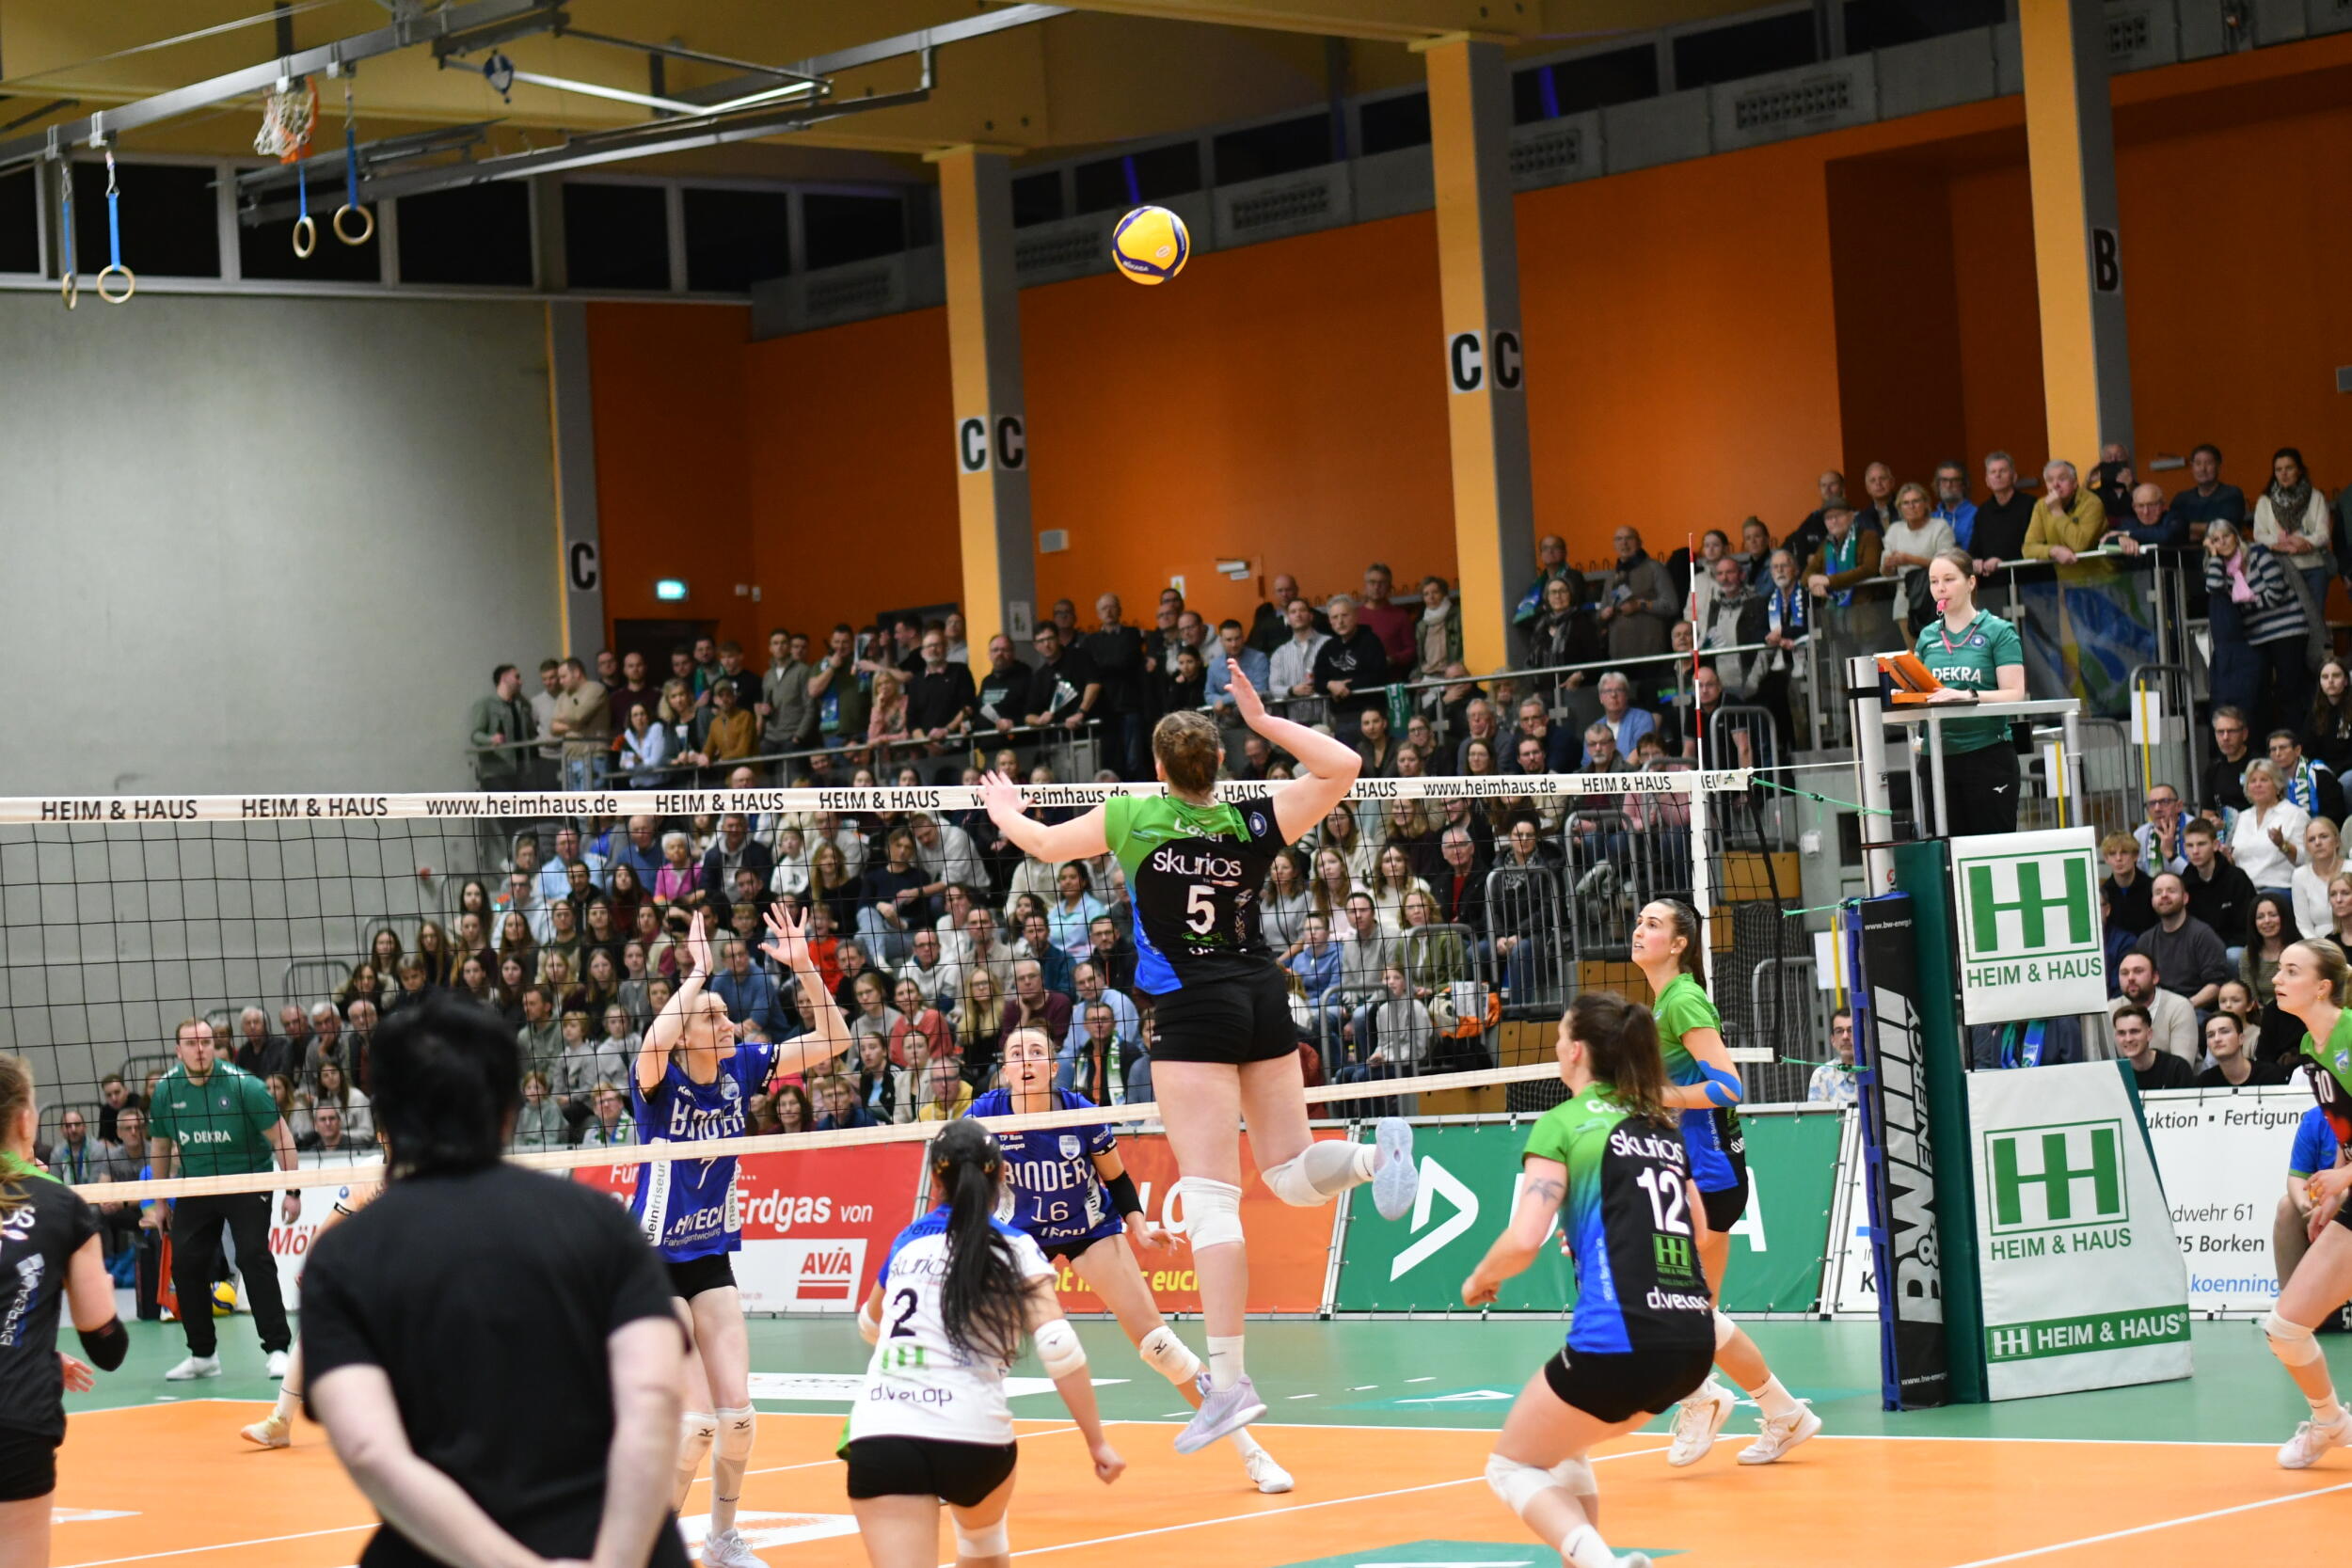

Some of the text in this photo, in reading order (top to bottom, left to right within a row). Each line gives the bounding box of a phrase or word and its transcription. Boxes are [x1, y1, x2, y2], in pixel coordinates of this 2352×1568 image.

[2093, 229, 2119, 292] B
[1451, 333, 1482, 391] C
[1494, 331, 1520, 389] C
[961, 418, 986, 471] C
[997, 416, 1025, 468] C
[570, 542, 596, 591] C
[1931, 666, 1981, 684] DEKRA
[41, 800, 102, 821] HEIM
[109, 800, 126, 820] &
[134, 800, 199, 819] HAUS
[241, 799, 299, 818] HEIM
[306, 798, 322, 817] &
[328, 797, 388, 816] HAUS
[426, 794, 618, 816] www.heimhaus.de
[656, 794, 706, 813] HEIM
[711, 793, 726, 812] &
[732, 792, 785, 811] HAUS
[819, 791, 866, 809] HEIM
[872, 790, 886, 809] &
[891, 789, 941, 808] HAUS
[1224, 784, 1267, 801] HAUS
[1357, 782, 1398, 799] HAUS
[1423, 778, 1557, 797] www.heimhaus.de
[1581, 776, 1618, 793] HEIM
[1621, 775, 1632, 791] &
[1636, 774, 1673, 791] HAUS
[1152, 848, 1242, 878] skurios
[1185, 884, 1216, 935] 5
[1966, 956, 2103, 989] HEIM & HAUS
[1906, 996, 1933, 1174] ENERGY
[2314, 1069, 2335, 1103] 10
[193, 1129, 232, 1144] DEKRA
[1610, 1129, 1684, 1164] skurios
[699, 1157, 719, 1190] 7
[739, 1189, 873, 1233] Erdgas von
[1030, 1196, 1069, 1223] 16
[1636, 1167, 1690, 1235] 12
[2169, 1204, 2254, 1223] dwehr 61
[1991, 1227, 2132, 1261] HEIM & HAUS
[2199, 1233, 2265, 1253] Borken
[801, 1246, 852, 1275] AVIA
[2186, 1273, 2280, 1298] .koenning
[890, 1288, 918, 1338] 2
[2037, 1322, 2094, 1350] HEIM
[2099, 1320, 2116, 1343] &
